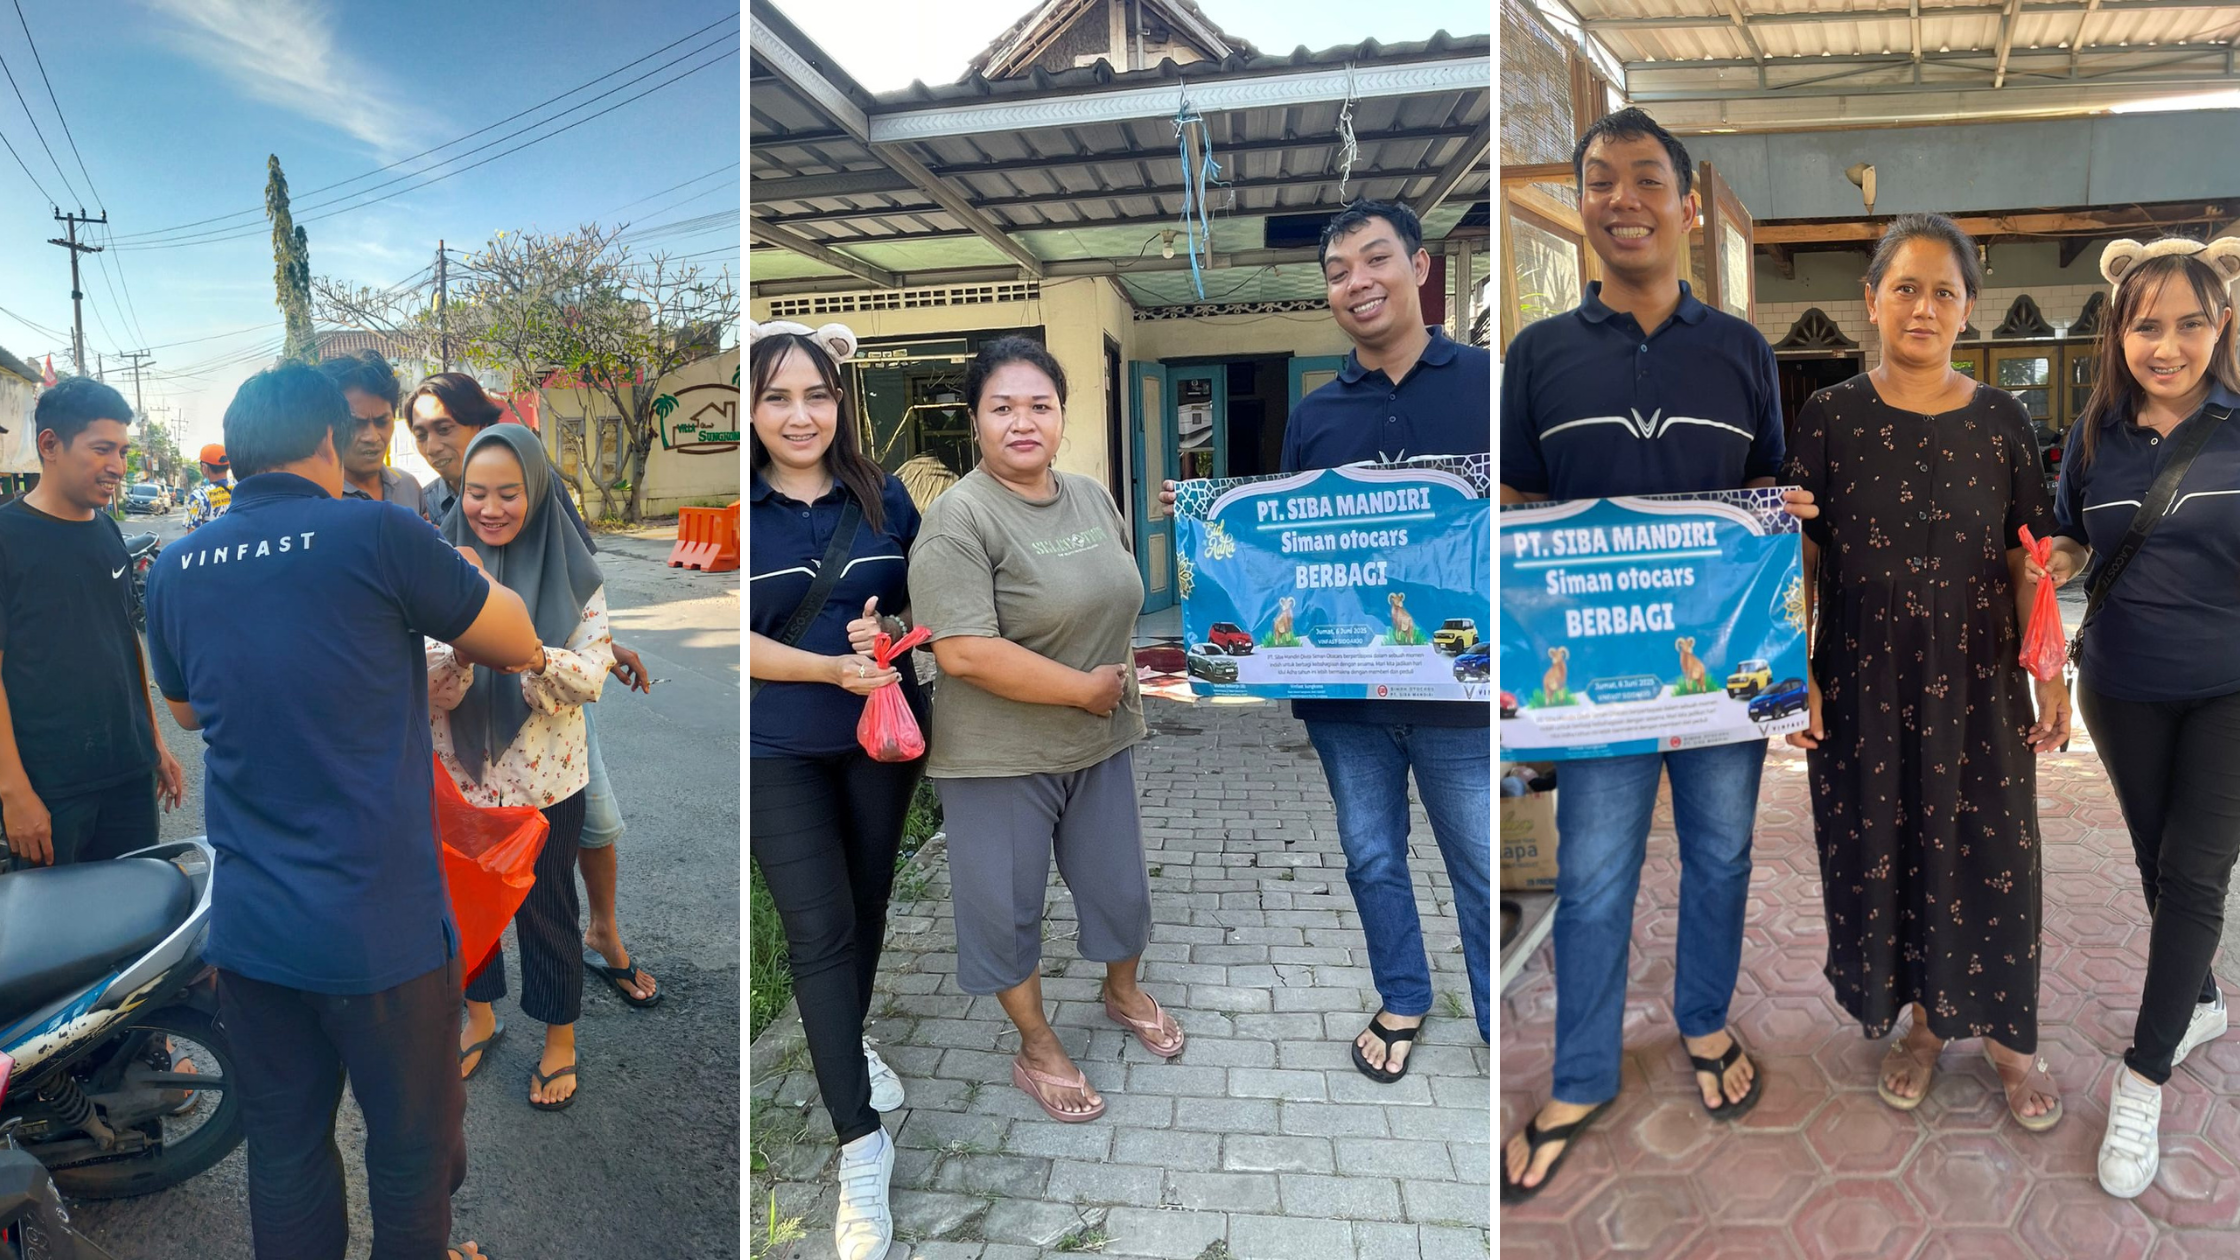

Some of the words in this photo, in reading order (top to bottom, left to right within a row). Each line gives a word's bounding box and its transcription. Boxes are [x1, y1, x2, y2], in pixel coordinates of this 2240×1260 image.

[1257, 500, 1284, 522] PT.
[1287, 497, 1333, 520] SIBA
[1336, 488, 1431, 516] MANDIRI
[181, 532, 314, 570] VINFAST
[1282, 531, 1336, 553] Siman
[1340, 529, 1408, 550] otocars
[1514, 531, 1549, 558] PT.
[1552, 527, 1609, 555] SIBA
[1612, 522, 1717, 552] MANDIRI
[1296, 561, 1388, 588] BERBAGI
[2102, 544, 2134, 588] LACOSTE
[1546, 569, 1613, 595] Siman
[1617, 568, 1694, 590] otocars
[1566, 602, 1675, 638] BERBAGI
[1773, 720, 1805, 731] VINFAST
[1500, 845, 1538, 862] apa
